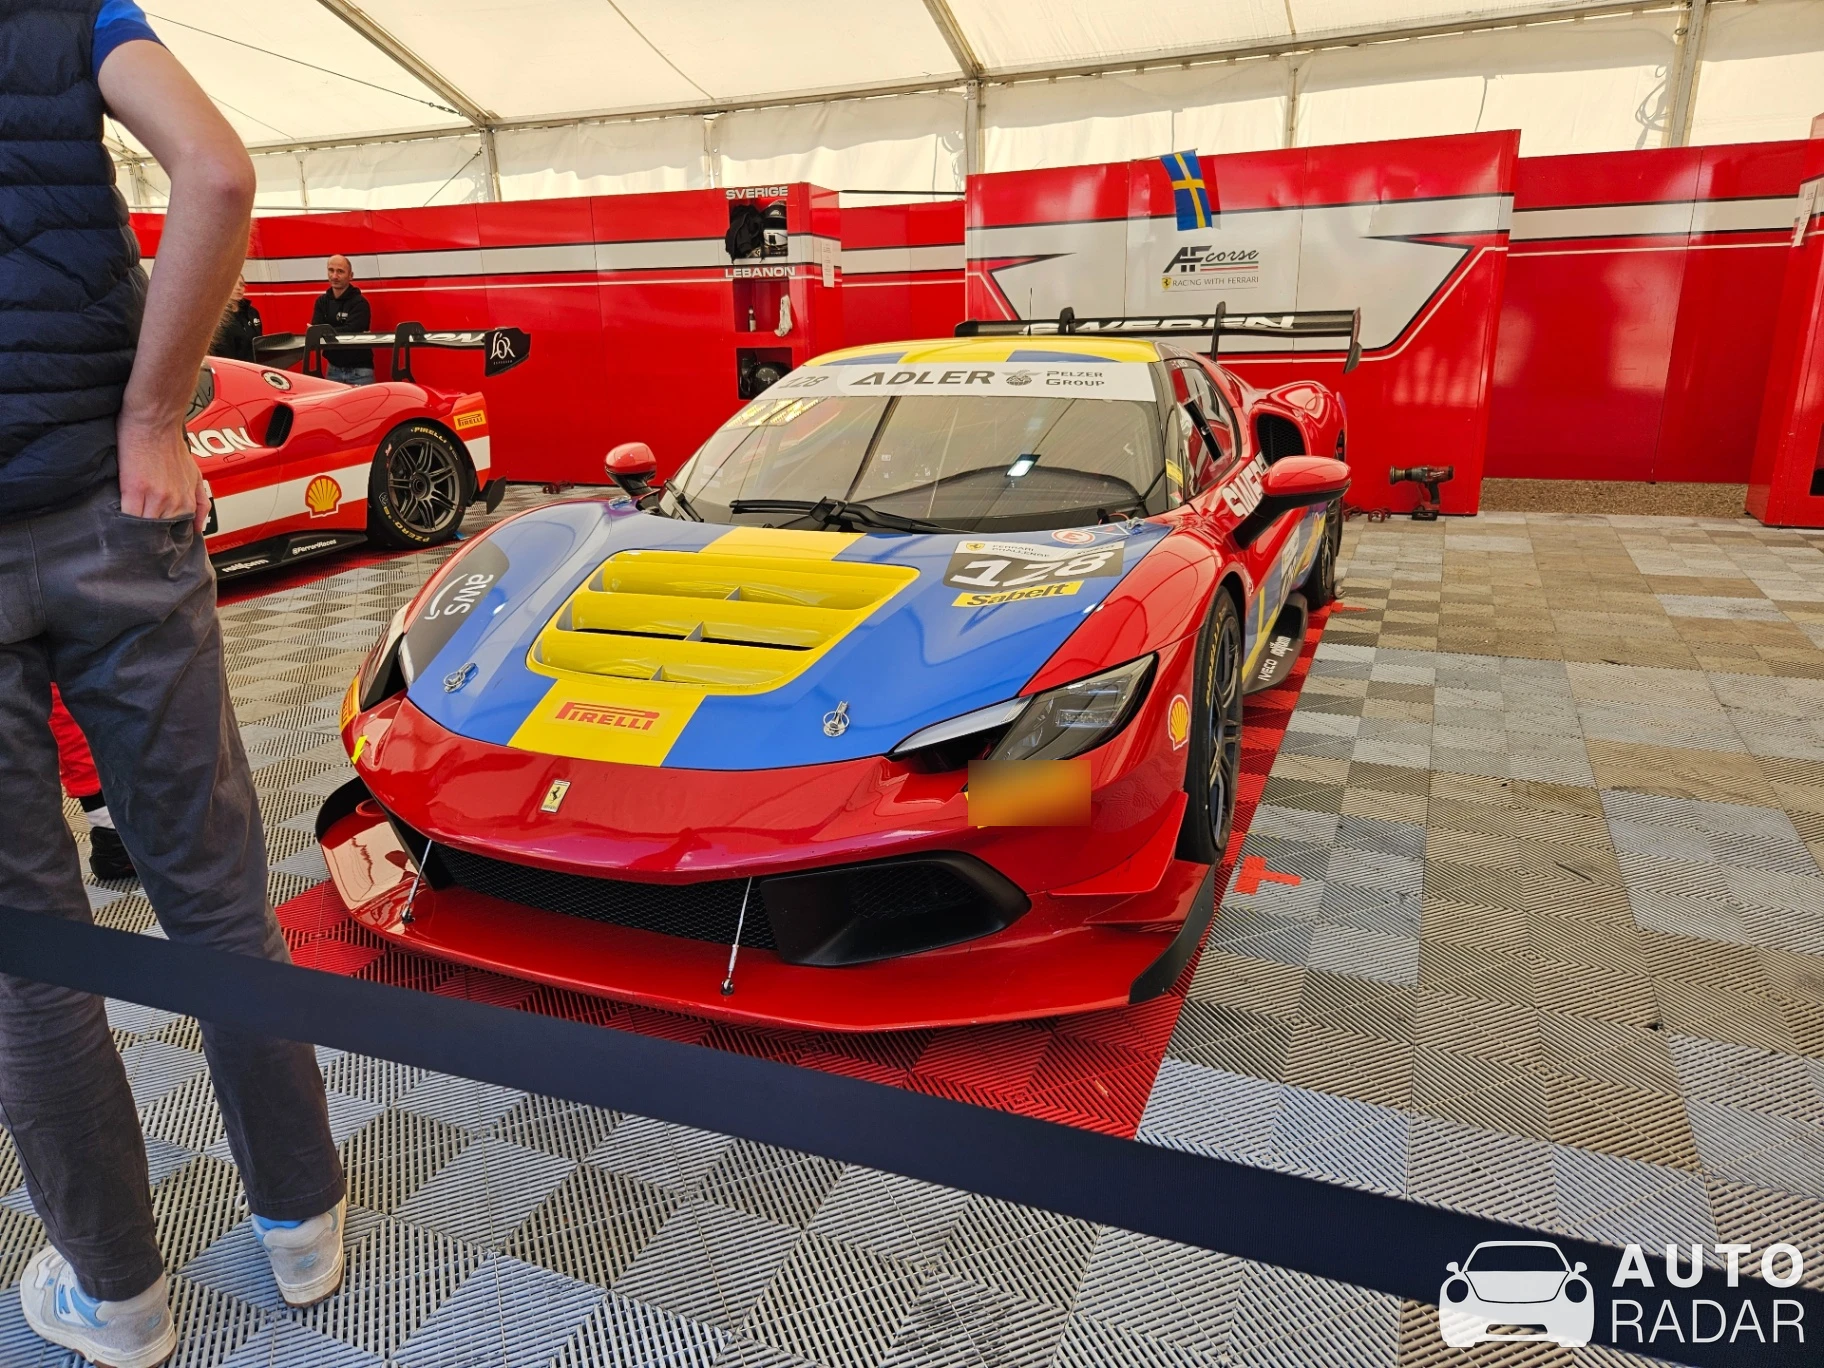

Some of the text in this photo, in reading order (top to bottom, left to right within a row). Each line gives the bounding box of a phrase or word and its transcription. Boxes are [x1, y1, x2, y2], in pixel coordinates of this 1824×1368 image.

[725, 186, 789, 200] SVERIGE
[1205, 249, 1260, 262] corse
[725, 266, 796, 279] LEBANON
[1172, 276, 1259, 287] RACING WITH FERRARI
[778, 375, 830, 389] 128
[849, 370, 996, 386] ADLER
[457, 413, 483, 427] PIRELLI
[413, 426, 448, 444] PIRELLI
[950, 551, 1115, 587] 128
[966, 582, 1073, 606] Sabelt
[1258, 658, 1278, 681] IVECO
[555, 701, 660, 731] PIRELLI
